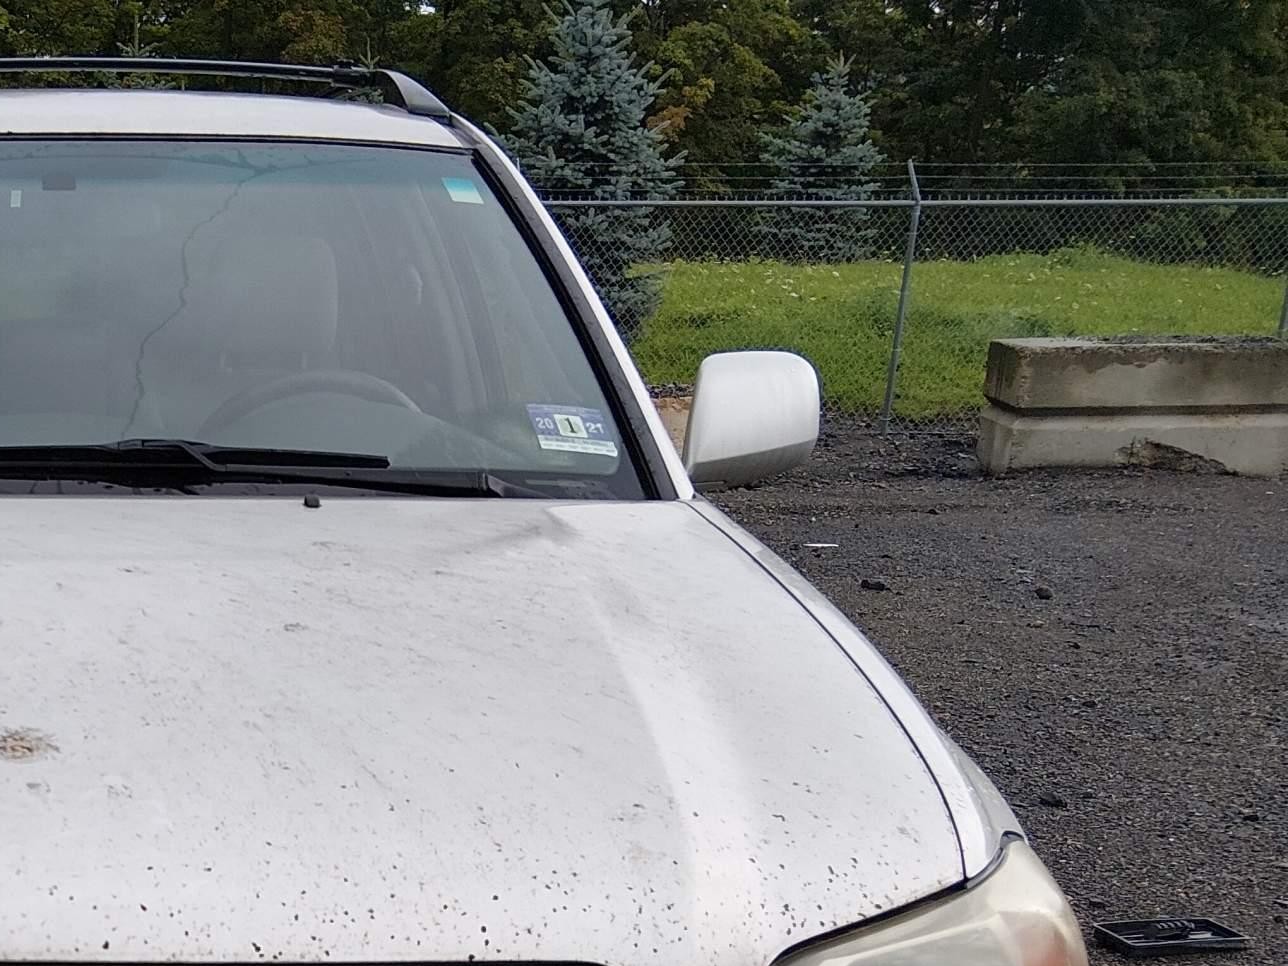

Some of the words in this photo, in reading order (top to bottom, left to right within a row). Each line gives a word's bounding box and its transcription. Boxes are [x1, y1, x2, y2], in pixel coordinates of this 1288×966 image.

[535, 417, 554, 430] 20
[564, 417, 578, 434] 1
[585, 422, 605, 434] 21
